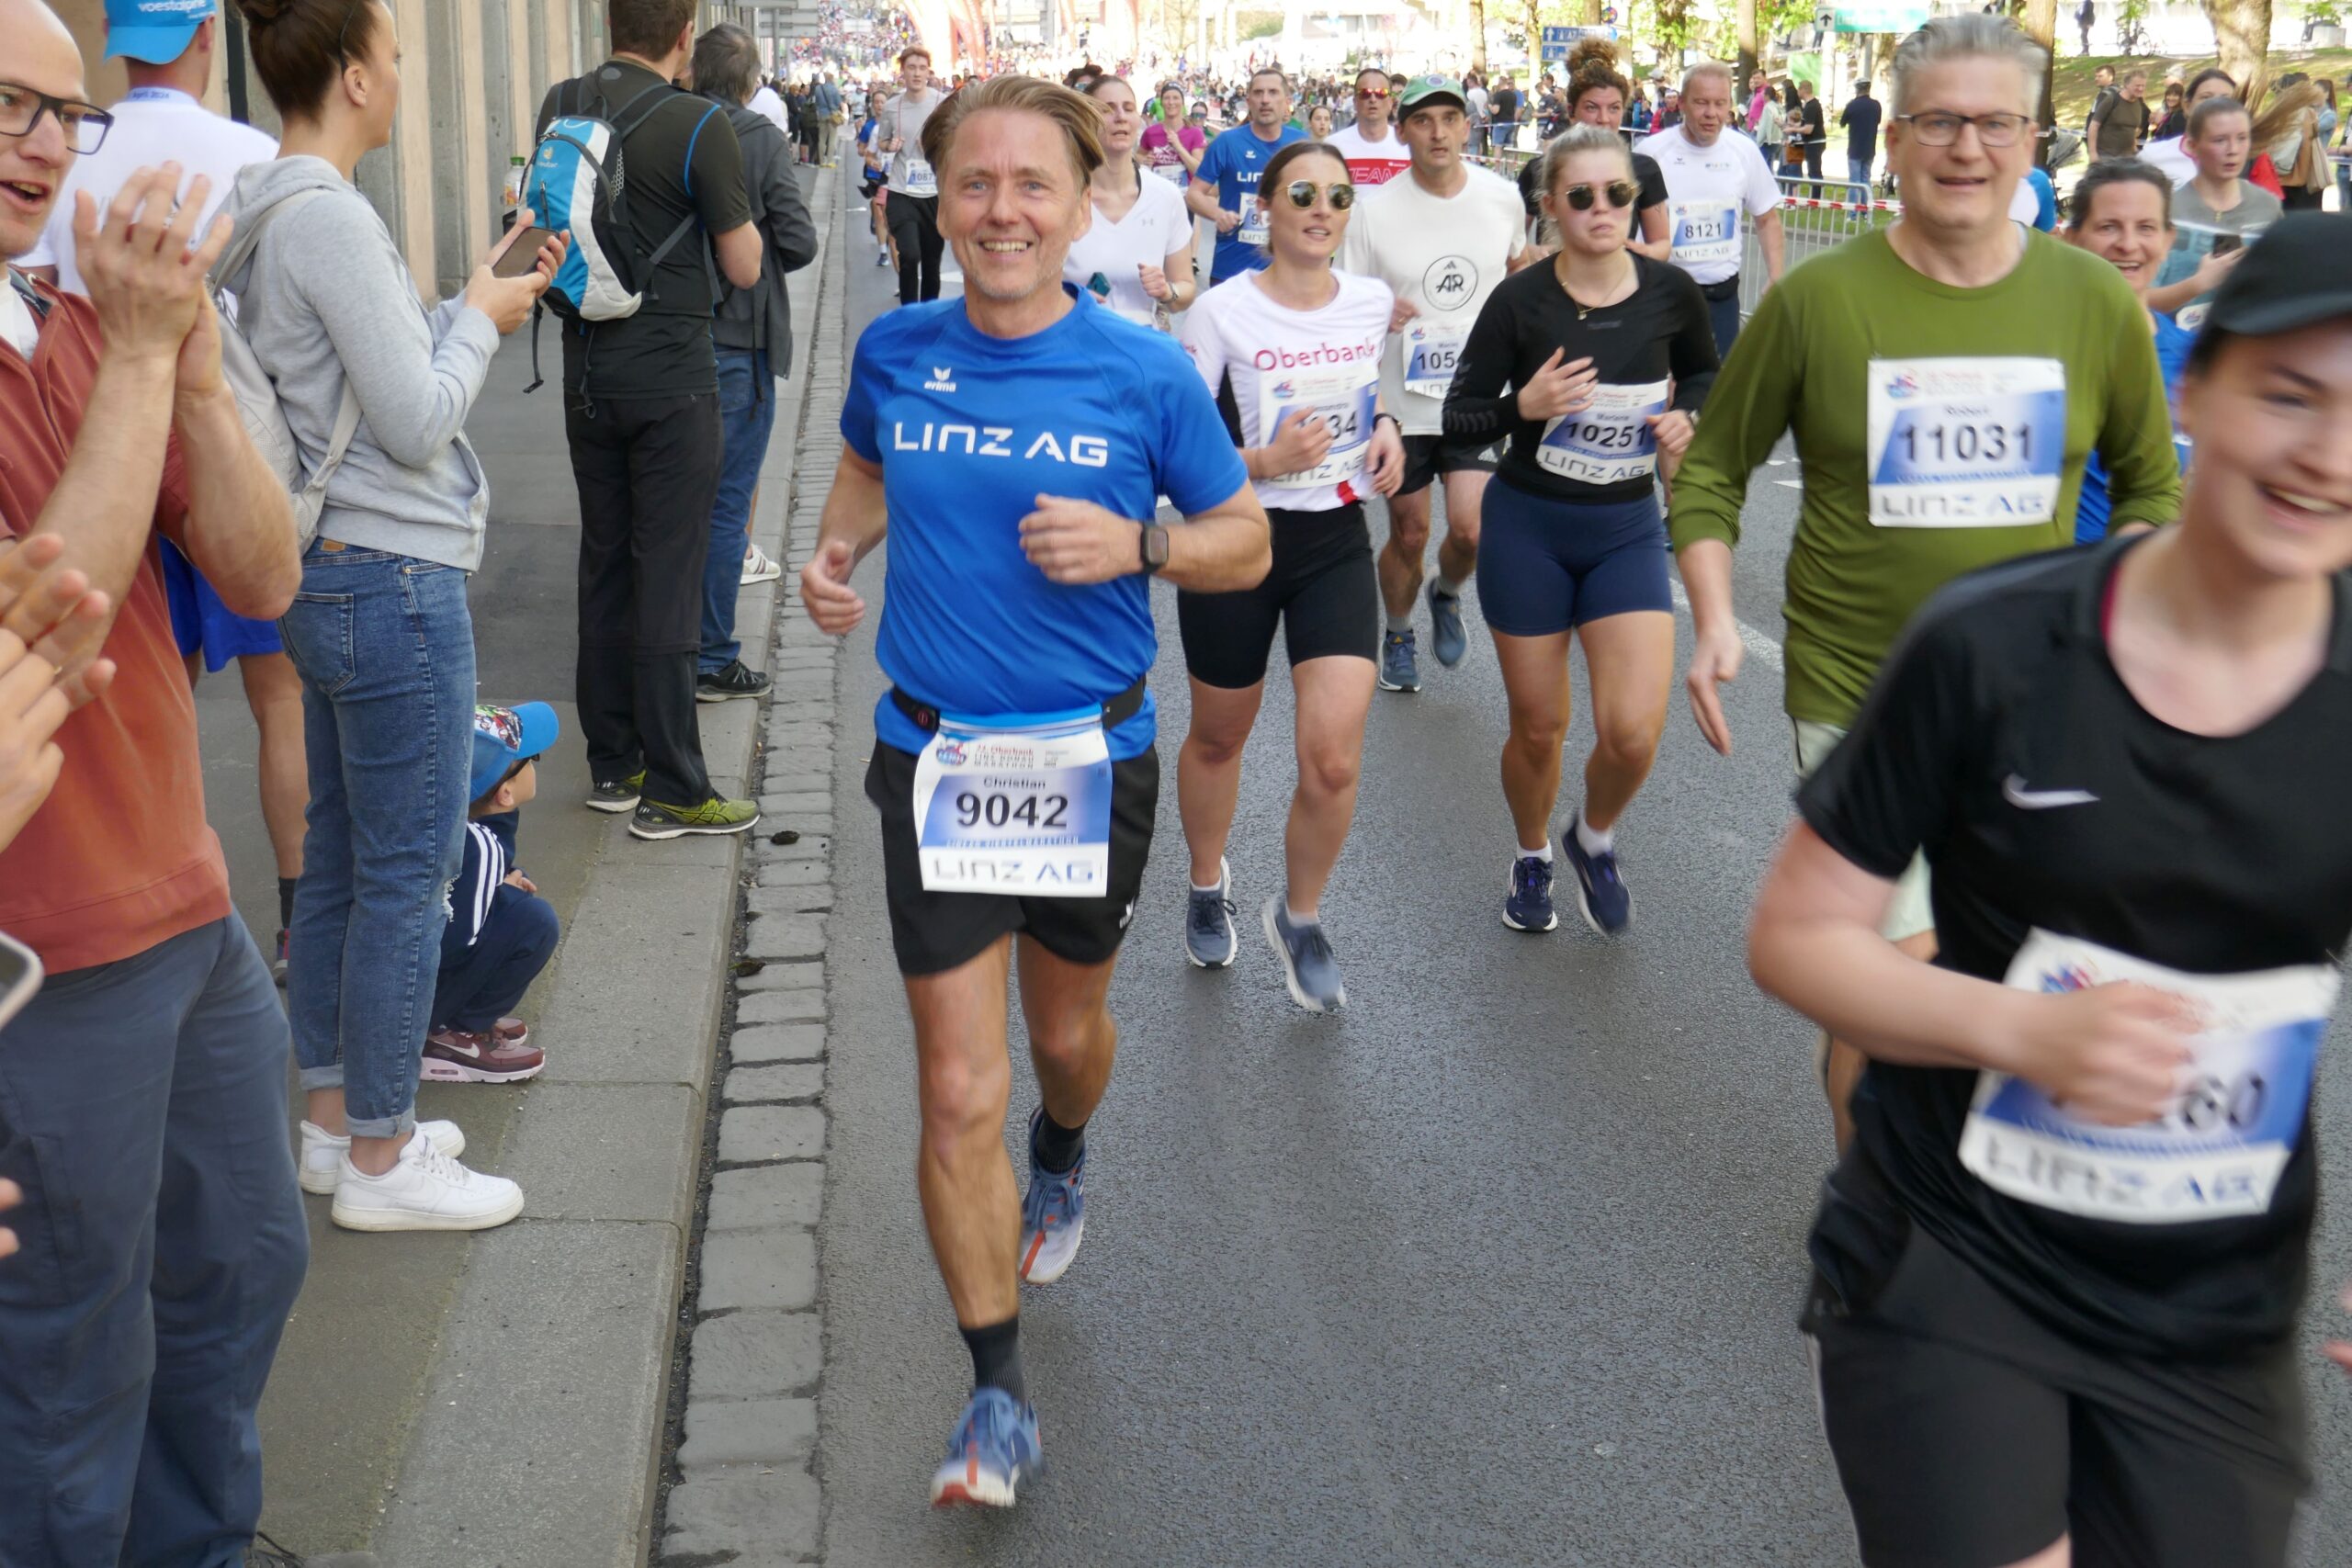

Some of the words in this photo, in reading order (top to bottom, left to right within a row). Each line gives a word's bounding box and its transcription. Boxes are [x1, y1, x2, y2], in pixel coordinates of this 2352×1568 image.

[1685, 222, 1722, 239] 8121
[1255, 337, 1375, 371] Oberbank
[923, 381, 956, 392] erima
[894, 422, 1012, 457] LINZ
[1024, 432, 1108, 468] AG
[1566, 423, 1647, 447] 10251
[1899, 423, 2033, 462] 11031
[1544, 451, 1607, 479] LINZ
[1609, 465, 1646, 479] AG
[1883, 493, 1977, 516] LINZ
[984, 775, 1046, 790] Christian
[956, 793, 1069, 829] 9042
[934, 858, 1025, 883] LINZ
[1035, 861, 1094, 884] AG
